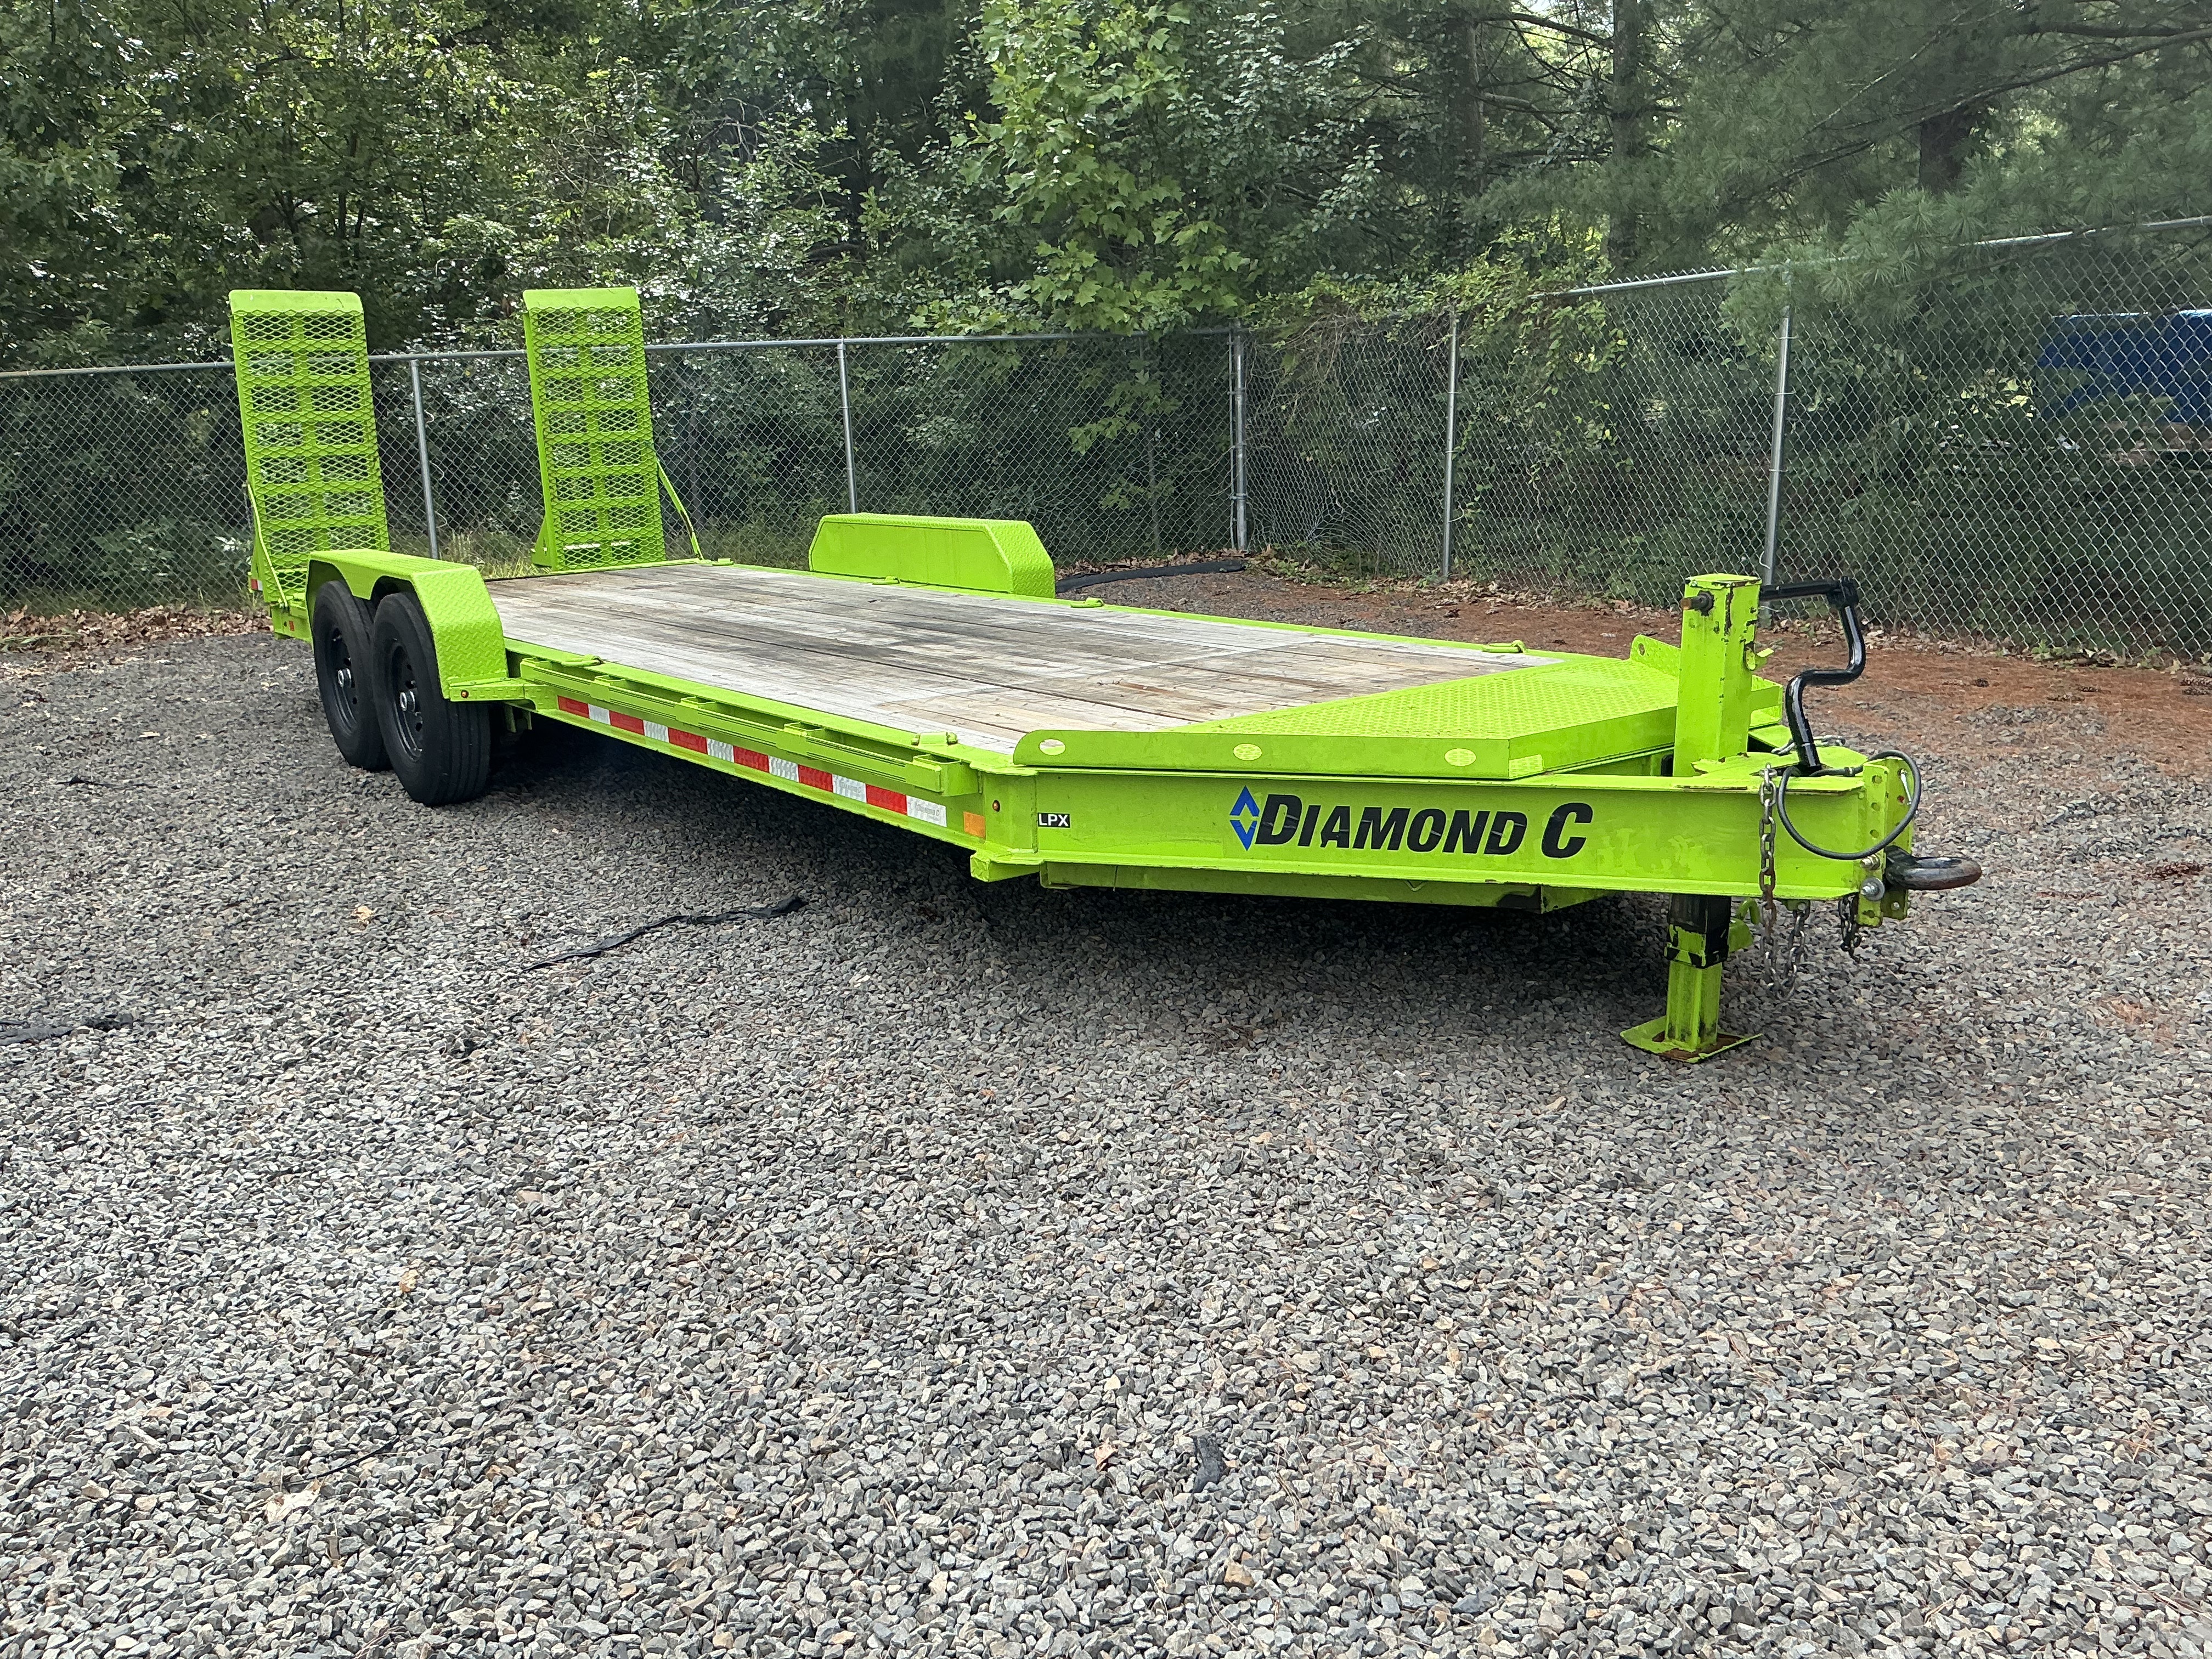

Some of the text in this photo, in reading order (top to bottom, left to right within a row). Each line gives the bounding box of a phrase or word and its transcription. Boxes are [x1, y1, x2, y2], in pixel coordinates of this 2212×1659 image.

[1039, 814, 1069, 827] LPX
[1255, 794, 1594, 859] DIAMOND C
